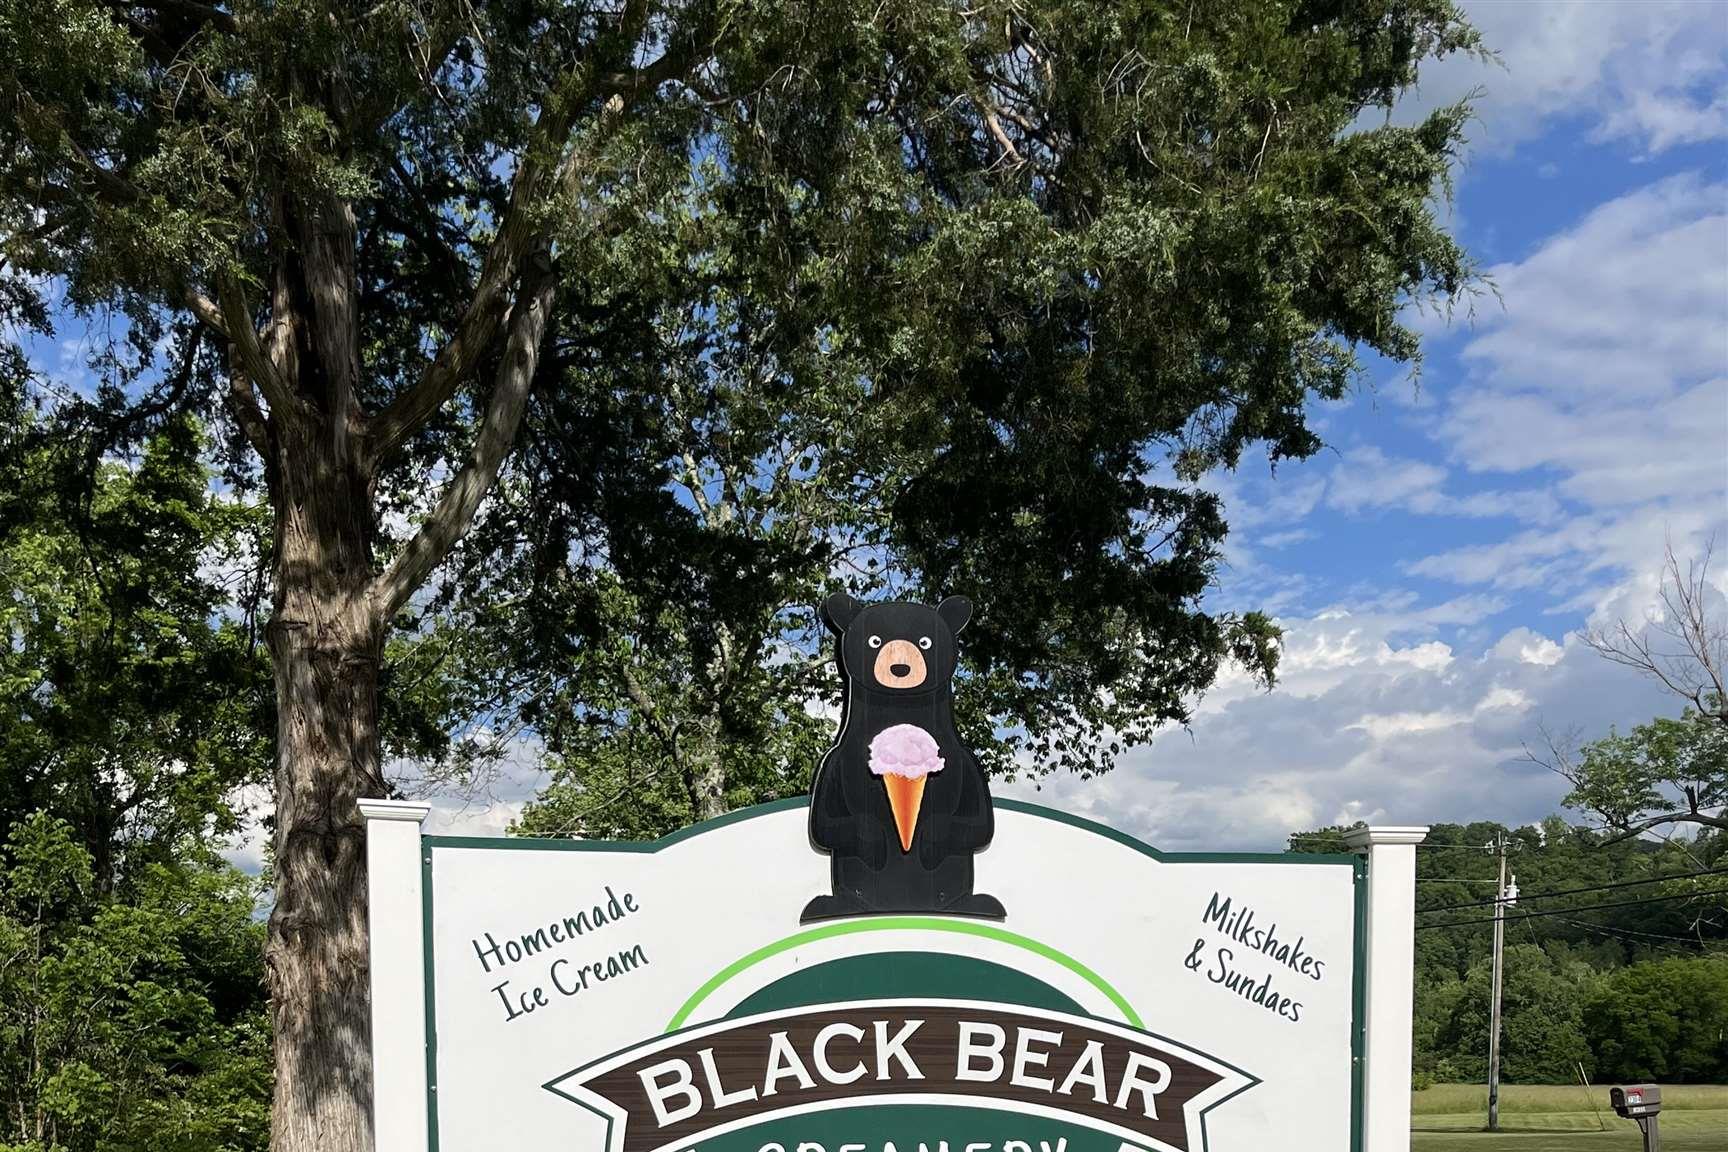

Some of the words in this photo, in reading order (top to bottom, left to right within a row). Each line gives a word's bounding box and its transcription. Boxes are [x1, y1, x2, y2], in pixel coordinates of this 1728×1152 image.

[472, 886, 639, 973] Homemade
[1202, 891, 1325, 980] Milkshakes
[491, 980, 549, 1022] Ice
[550, 944, 649, 996] Cream
[1184, 938, 1205, 972] &
[1207, 948, 1303, 1022] Sundaes
[636, 1019, 926, 1128] BLACK
[955, 1021, 1172, 1120] BEAR
